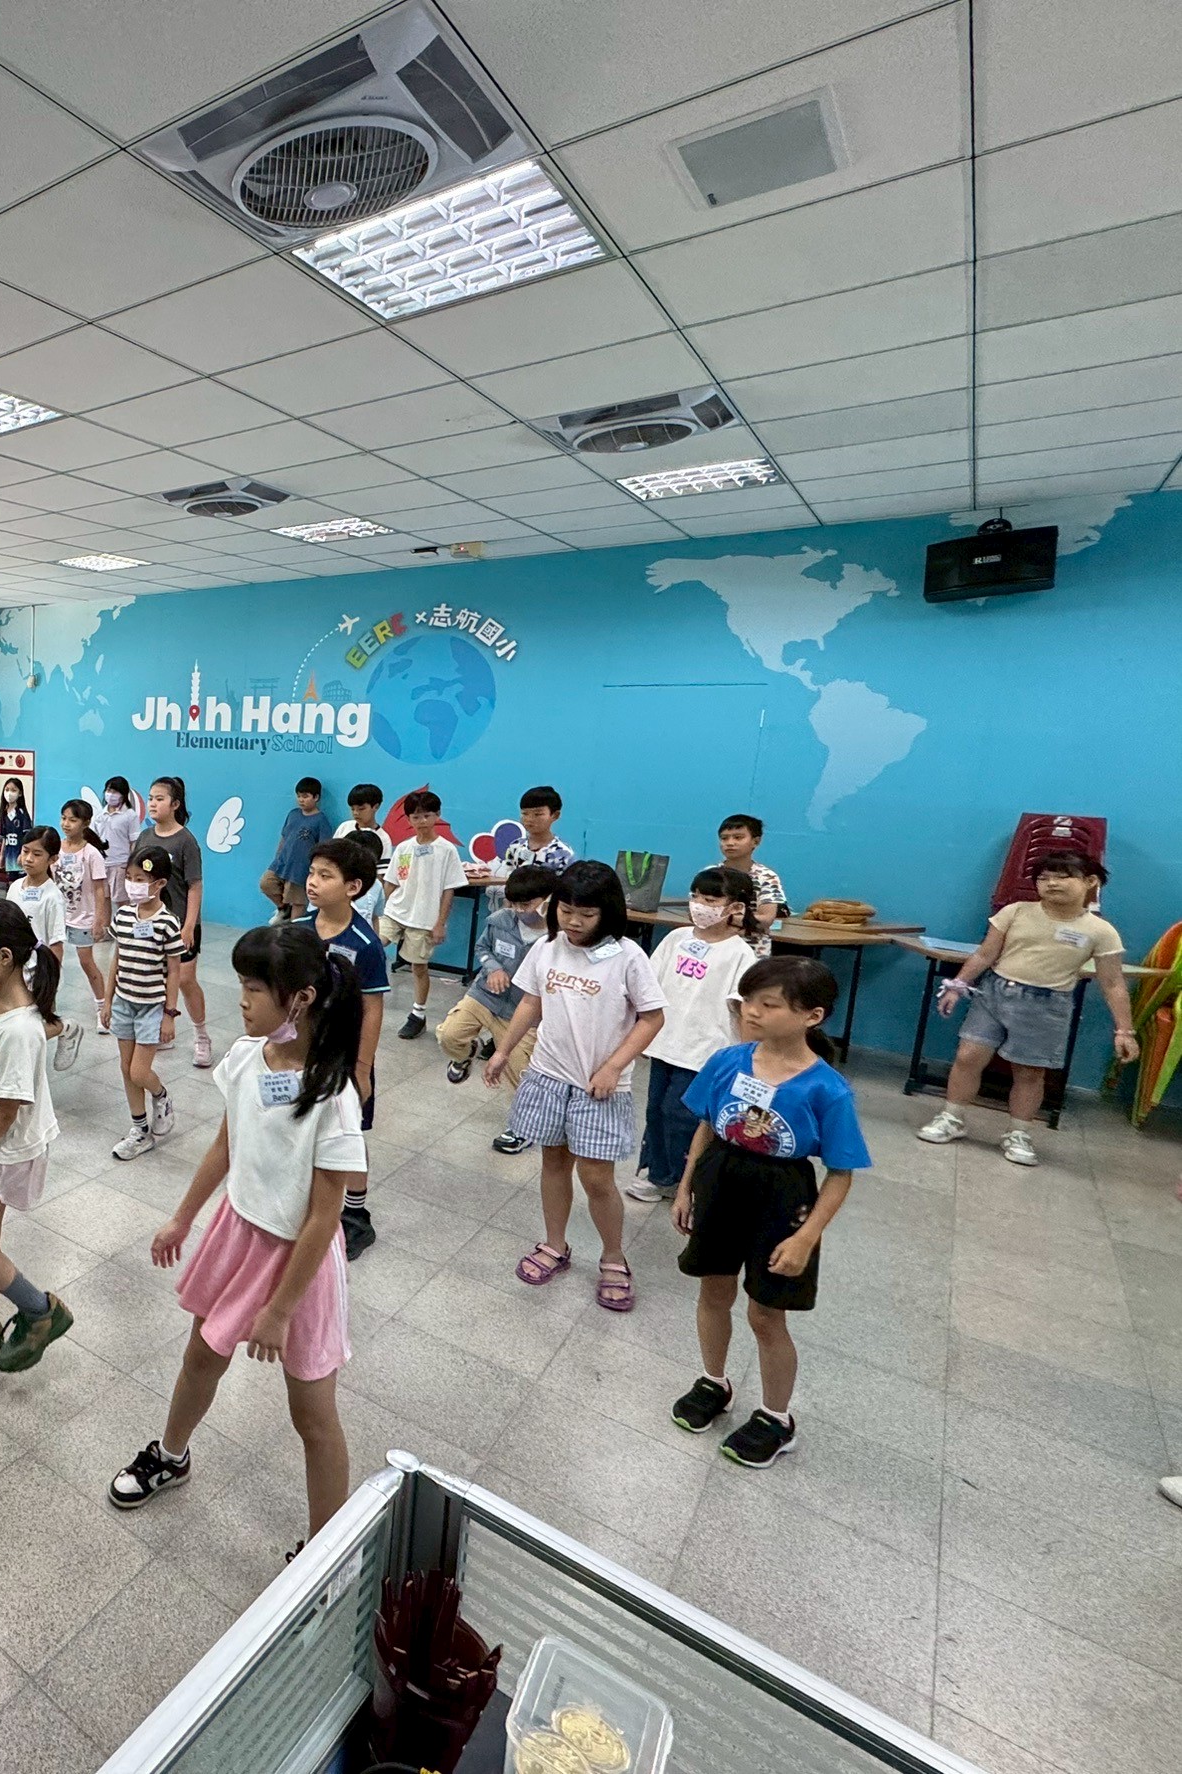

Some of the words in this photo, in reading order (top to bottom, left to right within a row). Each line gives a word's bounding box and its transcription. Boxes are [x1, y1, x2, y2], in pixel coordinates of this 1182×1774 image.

[428, 603, 518, 662] 志航國小
[242, 696, 372, 748] Hang
[176, 731, 271, 756] Elementary
[271, 734, 333, 755] School
[676, 955, 708, 980] YES
